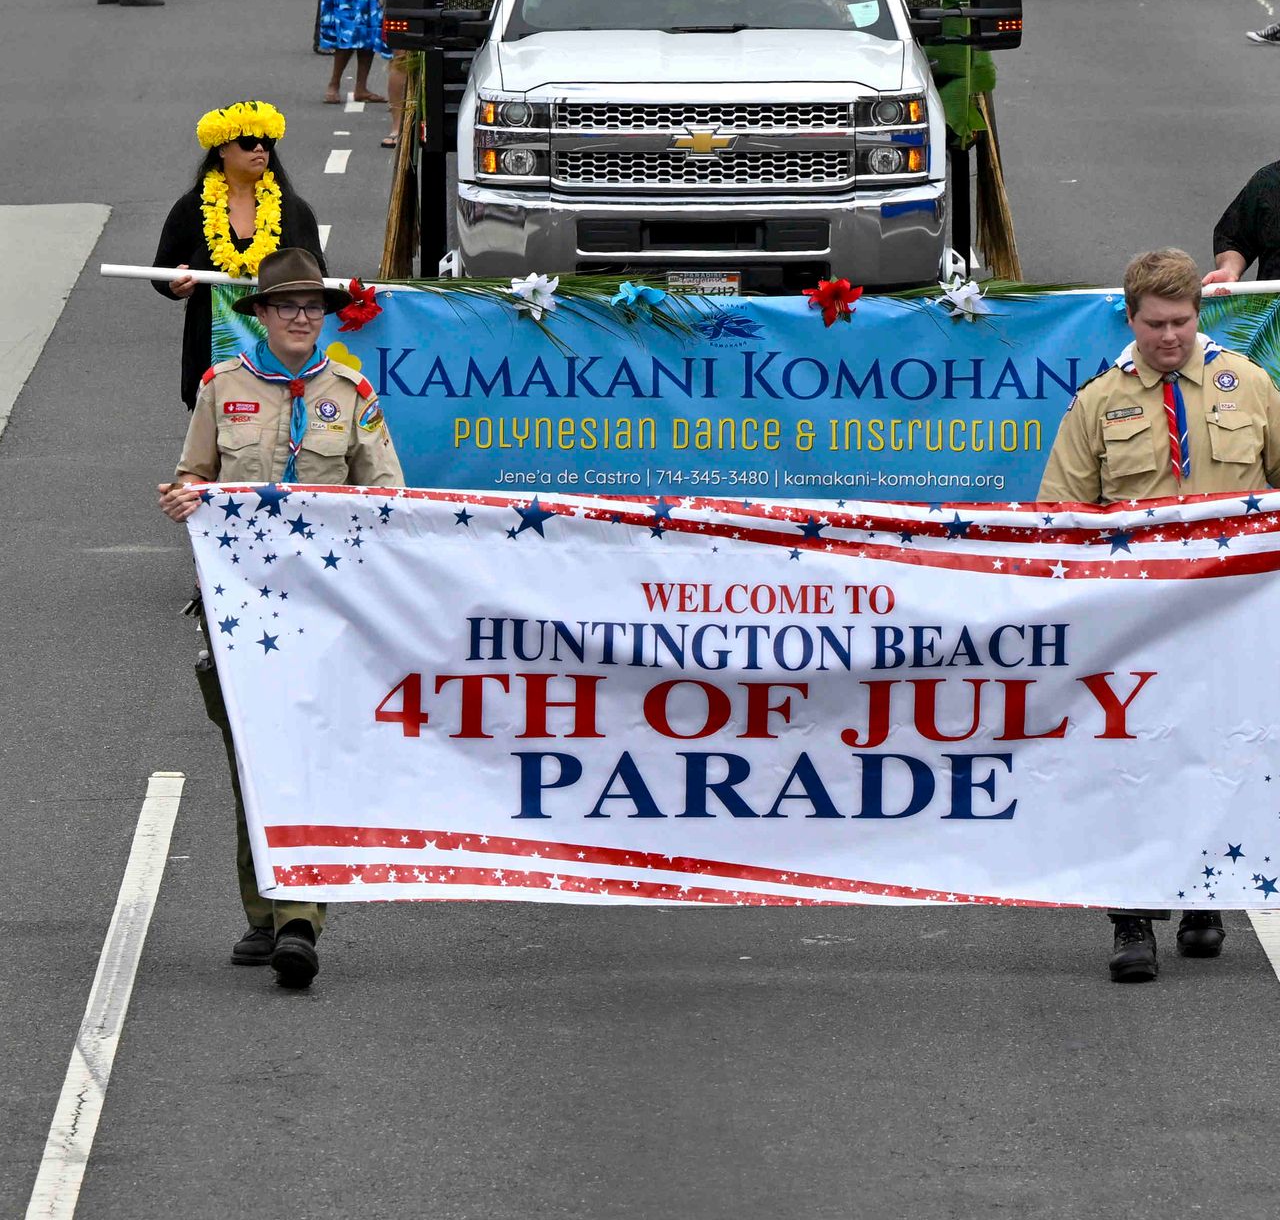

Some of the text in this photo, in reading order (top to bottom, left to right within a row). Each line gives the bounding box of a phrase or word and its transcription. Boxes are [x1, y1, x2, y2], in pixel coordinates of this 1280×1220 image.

[376, 347, 717, 398] KAMAKANI
[795, 418, 816, 450] &
[495, 469, 551, 484] Jene'a
[557, 469, 579, 484] de
[584, 469, 641, 485] Castro
[656, 470, 769, 485] 714-345-3480
[784, 470, 1005, 489] kamakani-komohana.org
[642, 582, 896, 615] WELCOME TO
[465, 617, 1071, 672] HUNTINGTON BEACH
[375, 671, 1158, 748] 4TH OF JULY
[510, 750, 1018, 820] PARADE
